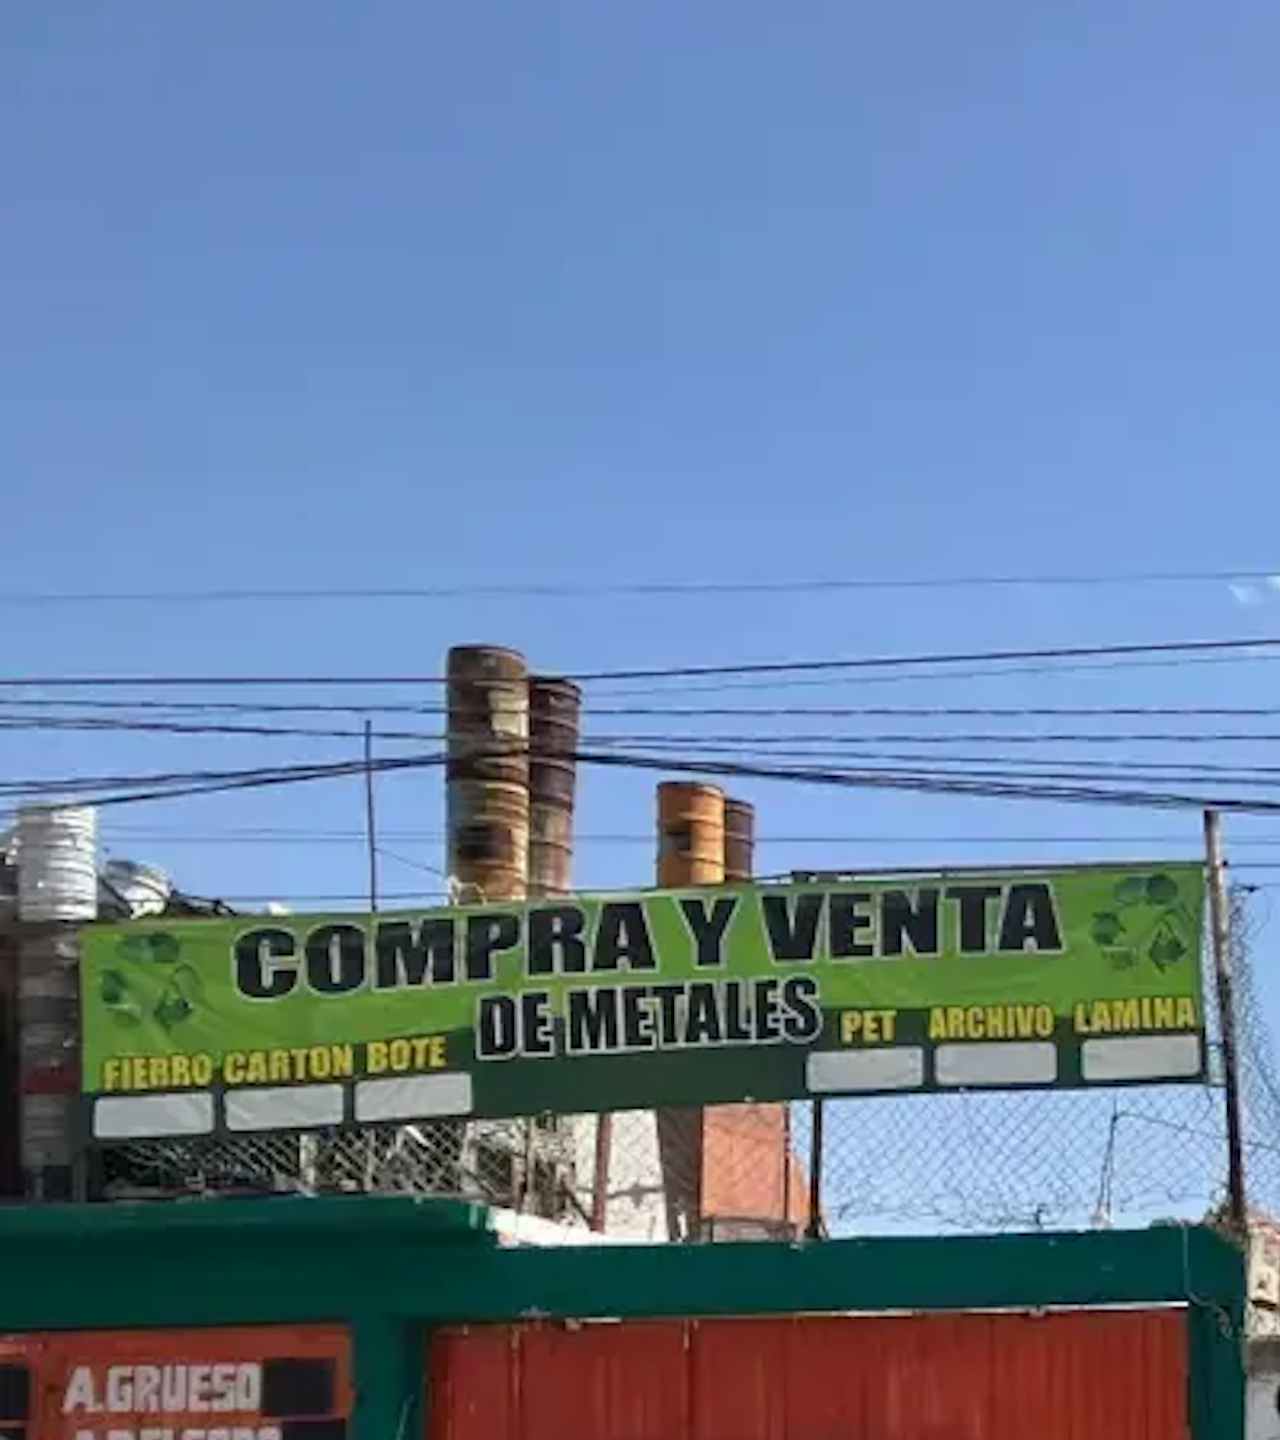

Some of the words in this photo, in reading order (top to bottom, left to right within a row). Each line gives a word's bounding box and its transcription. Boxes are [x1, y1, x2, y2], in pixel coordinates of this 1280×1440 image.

[233, 902, 659, 1000] COMPRA
[680, 895, 738, 967] Y
[763, 883, 1064, 963] VENTA
[104, 1053, 212, 1090] FIERRO
[224, 1045, 352, 1084] CARTON
[366, 1036, 448, 1074] BOTE
[842, 1009, 898, 1042] PET
[928, 1005, 1054, 1039] ARCHIVO
[1075, 997, 1197, 1034] LAMINA
[477, 992, 556, 1059] DE
[565, 975, 821, 1053] METALES
